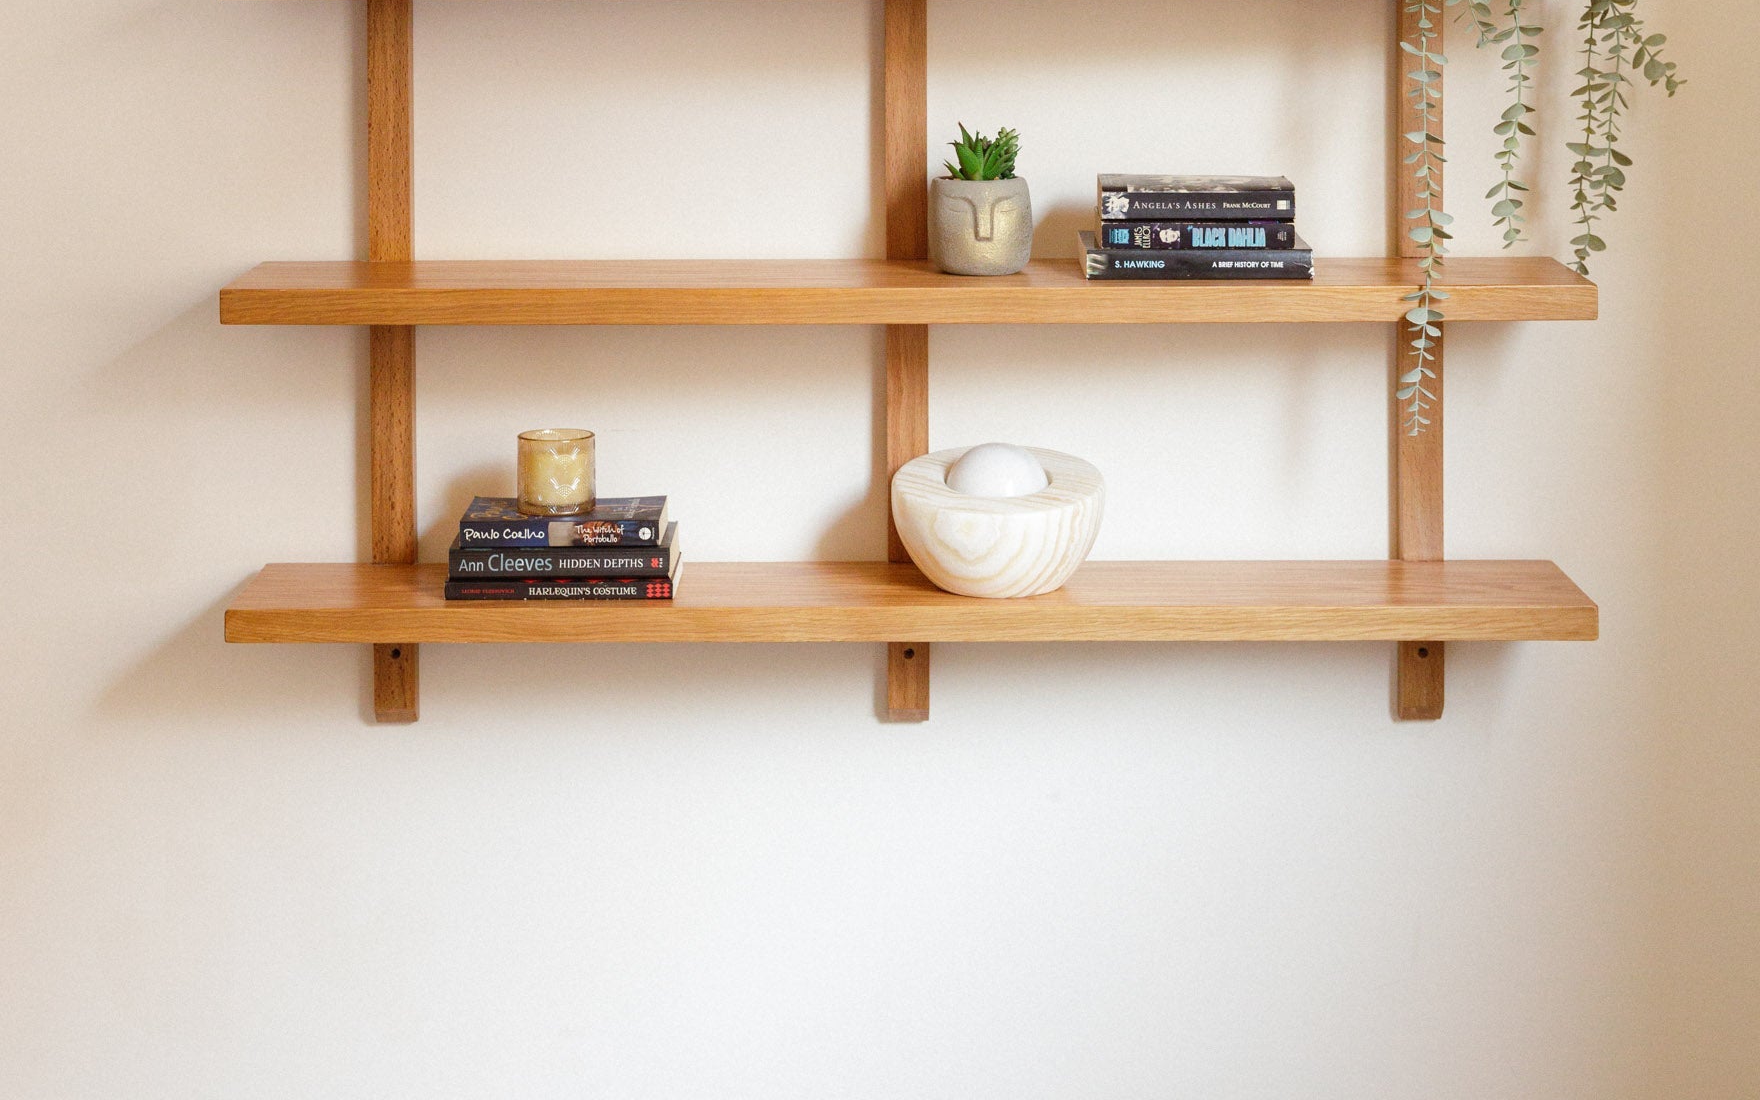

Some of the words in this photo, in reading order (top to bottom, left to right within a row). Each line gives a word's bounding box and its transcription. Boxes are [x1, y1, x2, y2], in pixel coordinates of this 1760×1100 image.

[1132, 201, 1181, 210] ANGELA'S
[1184, 201, 1217, 210] ASHES
[1133, 226, 1143, 247] JAMES
[1142, 225, 1151, 249] ELLROY
[1192, 227, 1226, 248] BLACK
[1228, 227, 1266, 248] DAHLIA
[1114, 260, 1122, 269] S.
[1124, 260, 1165, 269] HAWKING
[575, 524, 592, 534] The
[592, 523, 616, 534] Witch
[616, 522, 625, 534] of
[463, 527, 500, 542] Paulo
[502, 527, 545, 540] Coelho
[583, 533, 618, 544] Portobello
[458, 558, 484, 572] Ann
[487, 553, 552, 572] Cleeves
[559, 558, 601, 568] HIDDEN
[603, 558, 644, 568] DEPTHS
[528, 586, 591, 597] HARLEQUIN'S
[593, 586, 637, 597] COSTUME
